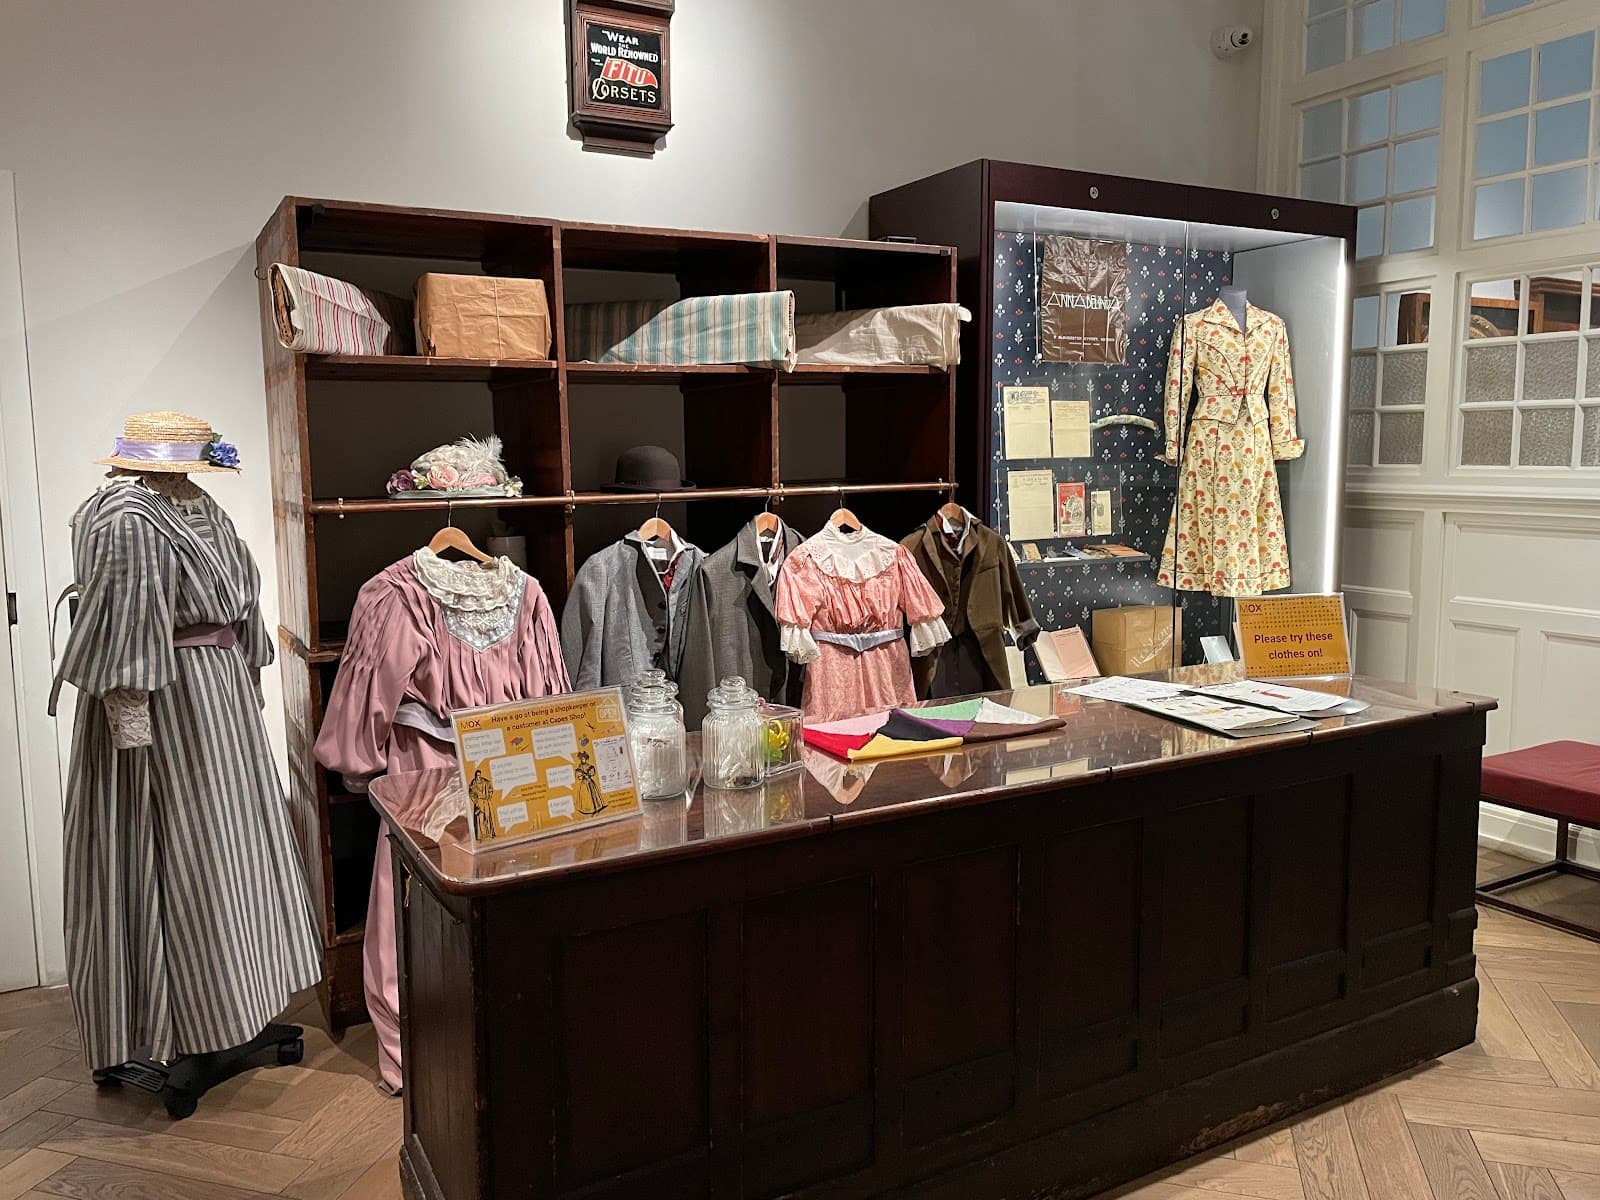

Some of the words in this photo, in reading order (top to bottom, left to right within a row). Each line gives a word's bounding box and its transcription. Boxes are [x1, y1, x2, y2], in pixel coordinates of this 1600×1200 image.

[602, 30, 639, 45] WEAR
[590, 41, 617, 56] WORLD
[618, 47, 659, 63] RENOWNED
[592, 78, 656, 103] CORSETS
[1240, 604, 1262, 612] MOX
[1254, 634, 1288, 644] Please
[1290, 634, 1303, 644] try
[1306, 632, 1333, 641] these
[1268, 649, 1305, 660] clothes
[1307, 648, 1323, 658] on!
[491, 715, 508, 723] Have
[514, 713, 523, 721] go
[531, 709, 549, 717] being
[554, 701, 589, 713] shopkeeper
[460, 720, 481, 729] MOX
[511, 720, 541, 730] customer
[549, 716, 568, 724] Capes
[569, 711, 586, 720] Shop!
